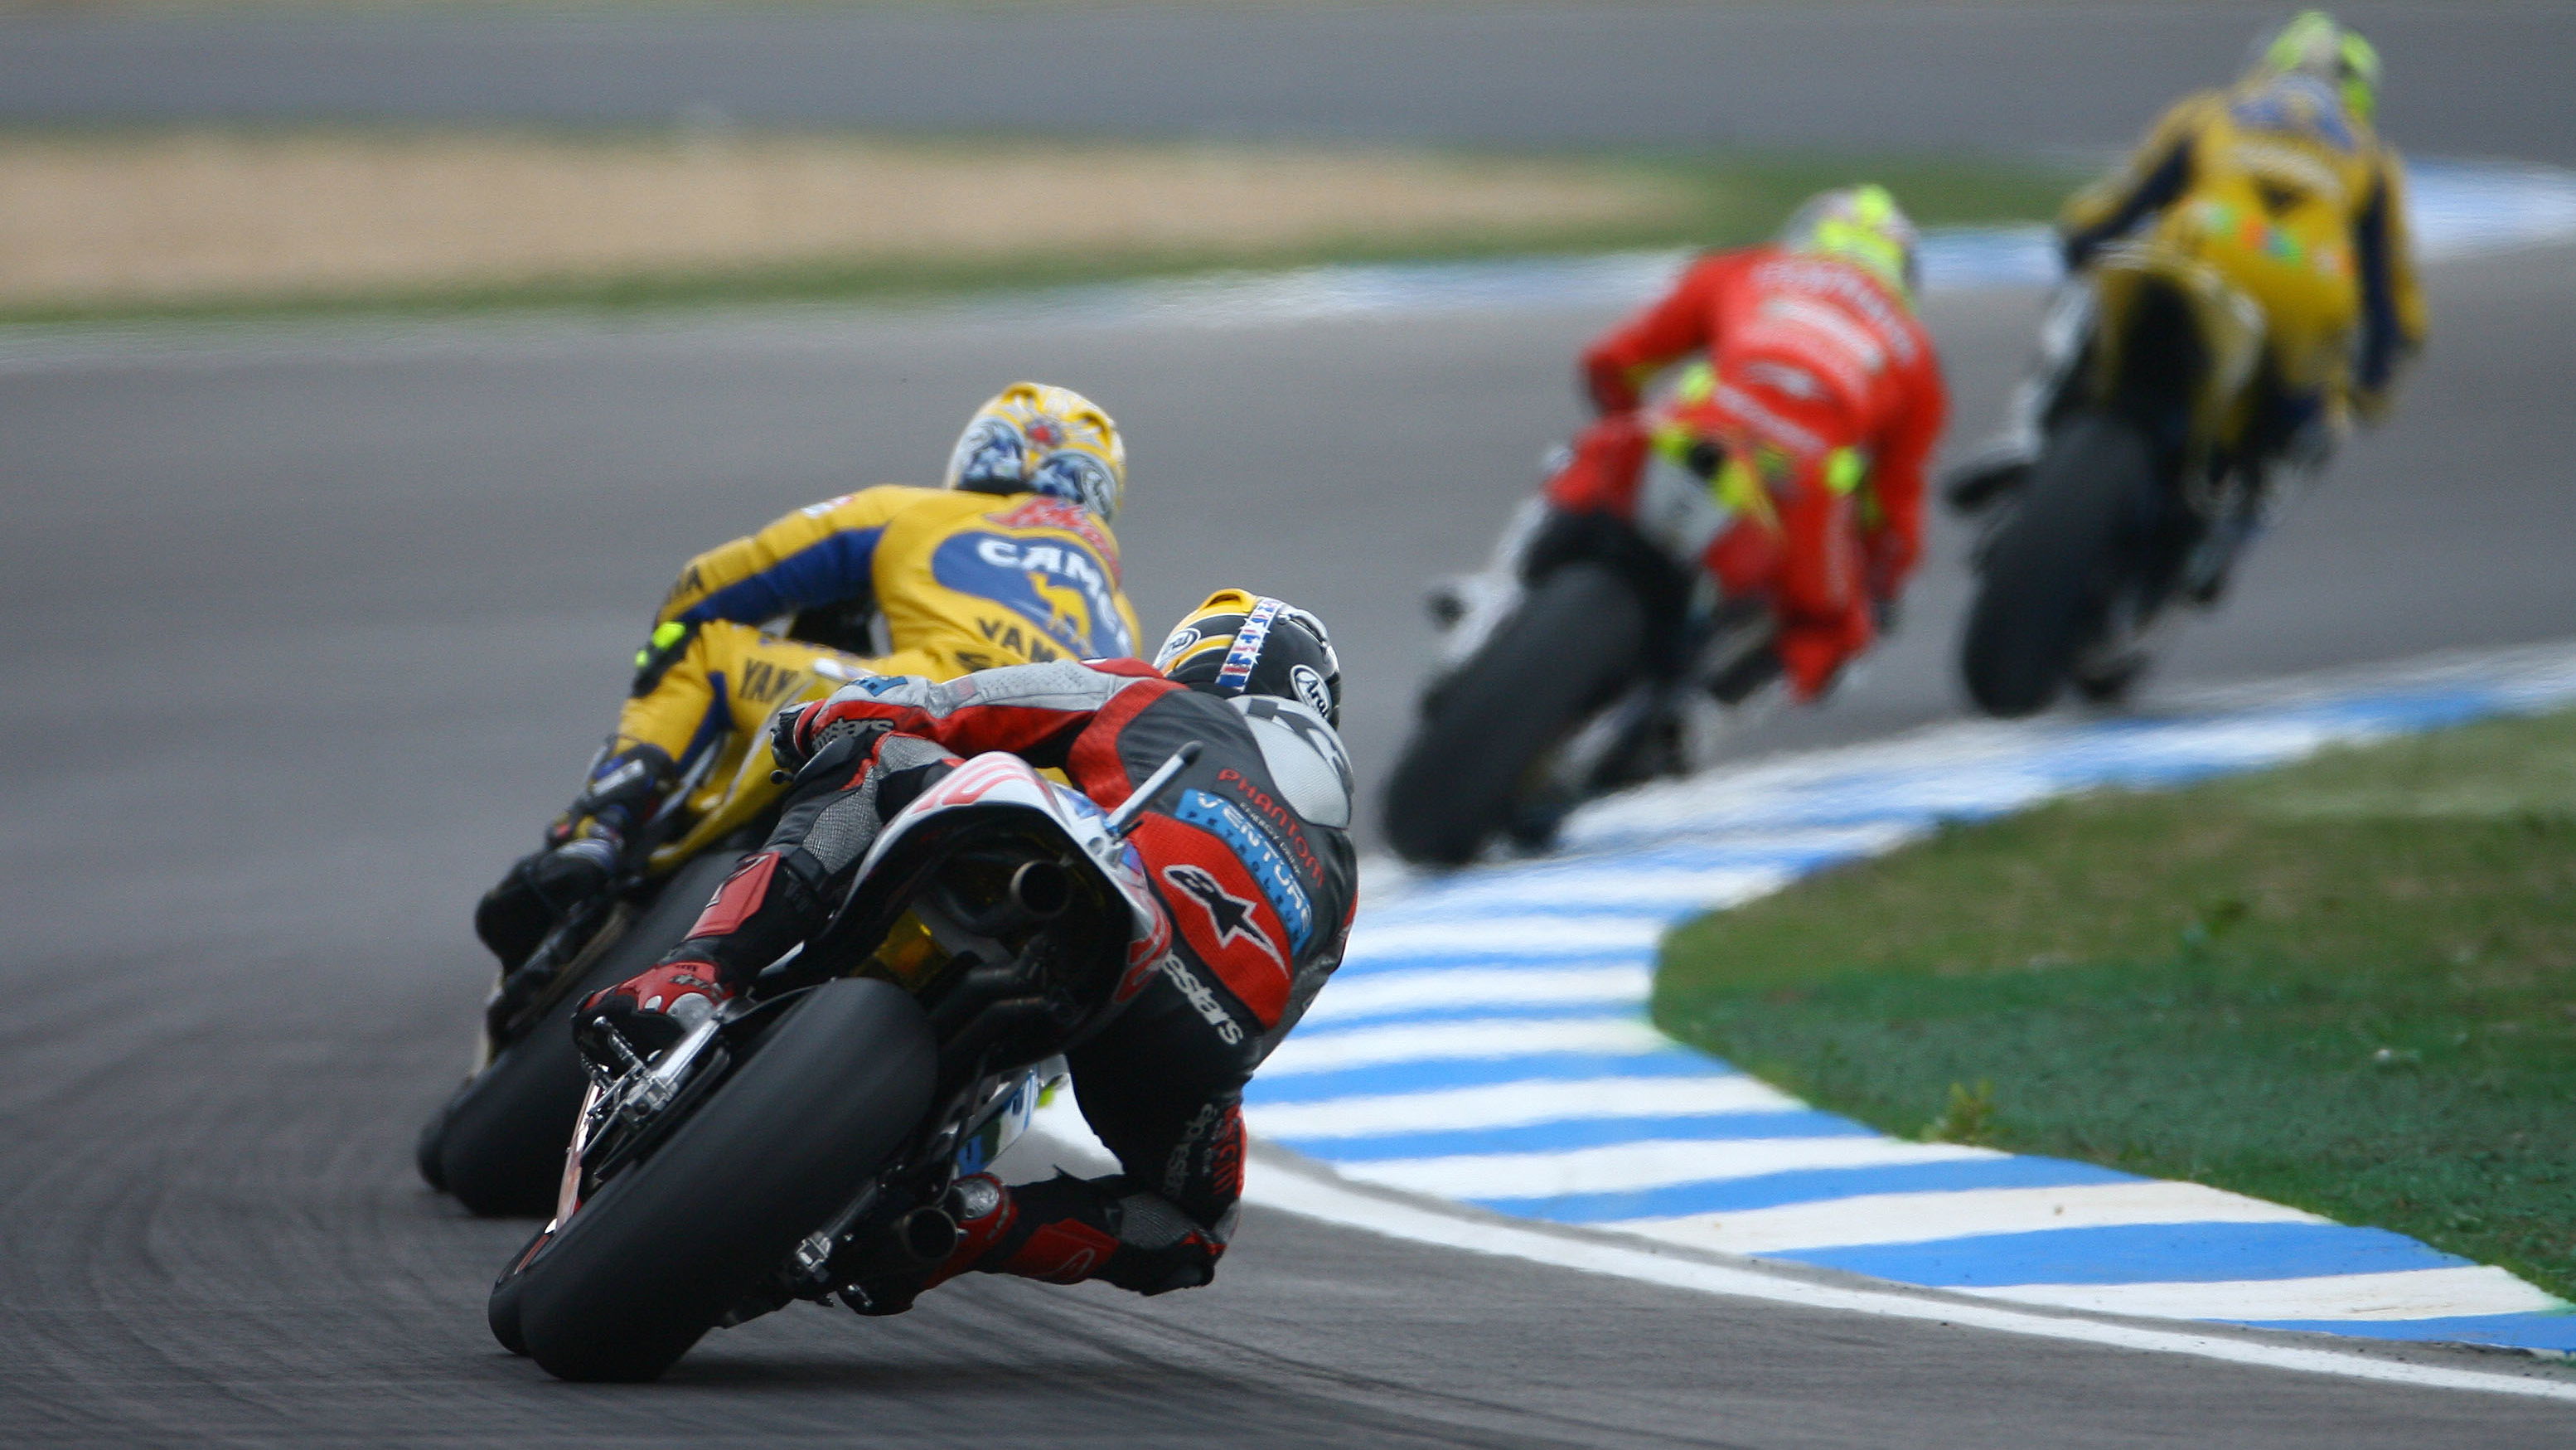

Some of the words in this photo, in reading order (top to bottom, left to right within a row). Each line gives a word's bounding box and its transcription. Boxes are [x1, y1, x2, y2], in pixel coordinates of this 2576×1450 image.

[1197, 792, 1312, 933] VENTURE
[1218, 769, 1324, 889] PHANTOM
[1161, 951, 1243, 1045] estars
